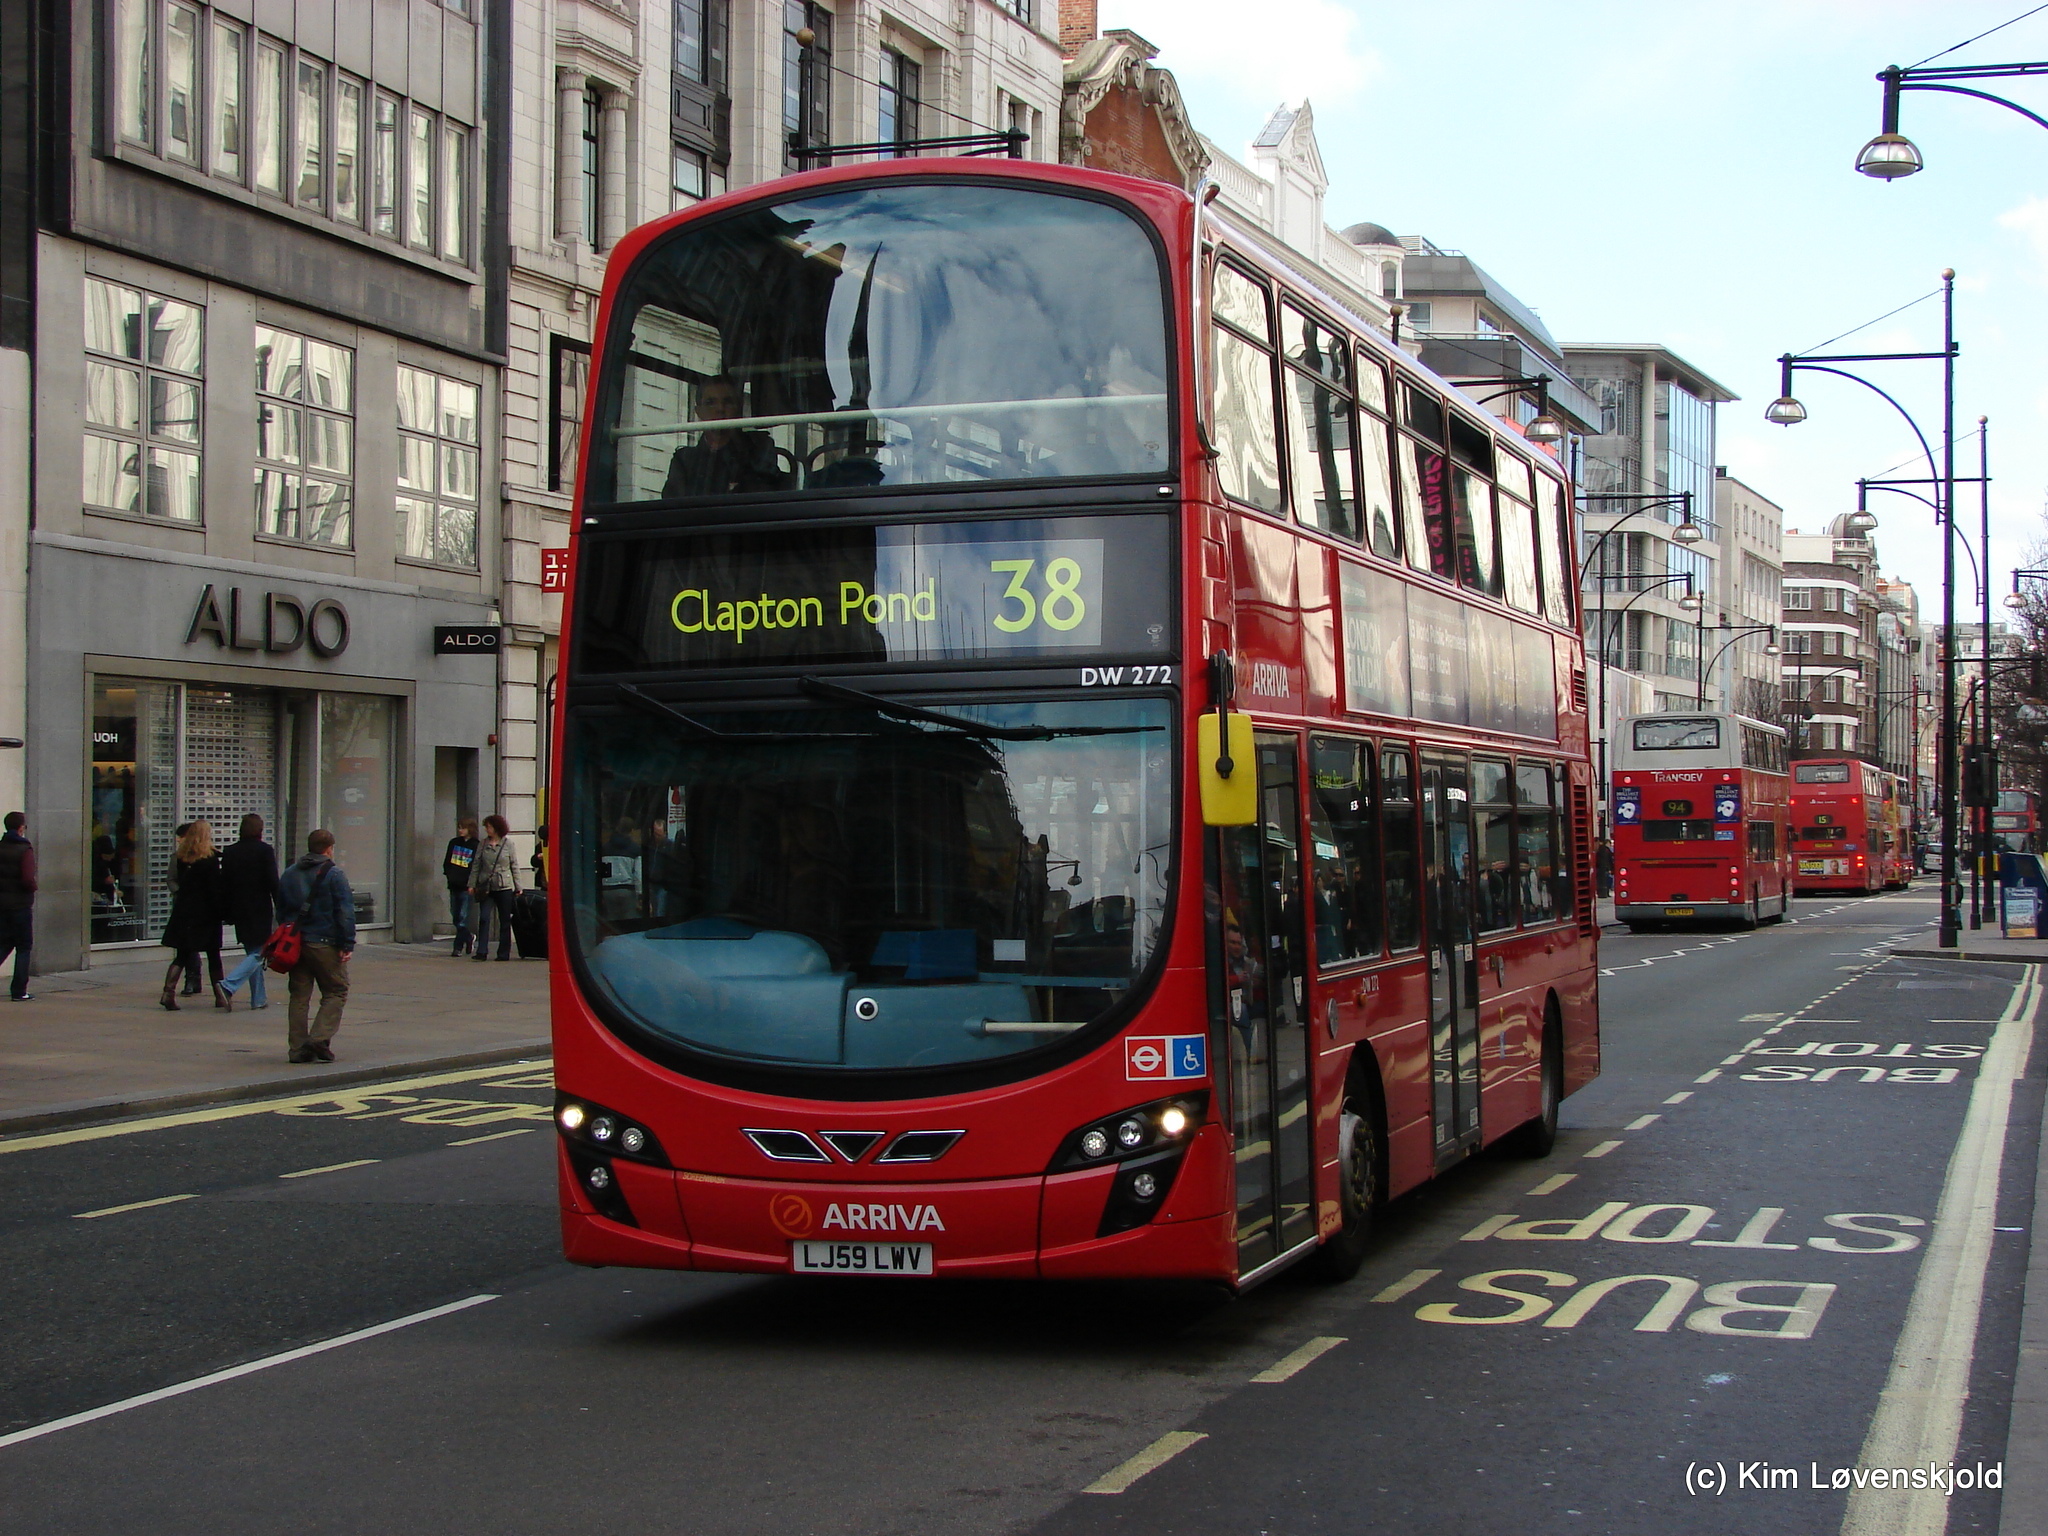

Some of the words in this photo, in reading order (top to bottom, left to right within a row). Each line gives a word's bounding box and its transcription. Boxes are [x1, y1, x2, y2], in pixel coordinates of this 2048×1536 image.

[991, 557, 1085, 633] 38
[184, 584, 350, 658] ALDO
[671, 589, 822, 644] Clapton
[840, 577, 936, 625] Pond
[443, 634, 496, 646] ALDO
[1344, 616, 1381, 655] LONDON
[1081, 666, 1124, 687] DW
[1131, 665, 1172, 685] 272
[1252, 662, 1290, 699] ARRIVA
[1650, 771, 1703, 783] TRANSDEV
[1668, 801, 1687, 814] 94
[1818, 815, 1827, 824] 15
[1751, 1042, 1986, 1059] STOP
[1739, 1066, 1960, 1083] BUS
[822, 1203, 946, 1231] ARRIVA
[1493, 1201, 1926, 1253] STOP
[803, 1244, 867, 1270] LJ59
[874, 1246, 921, 1270] LWV
[1414, 1269, 1837, 1338] BUS
